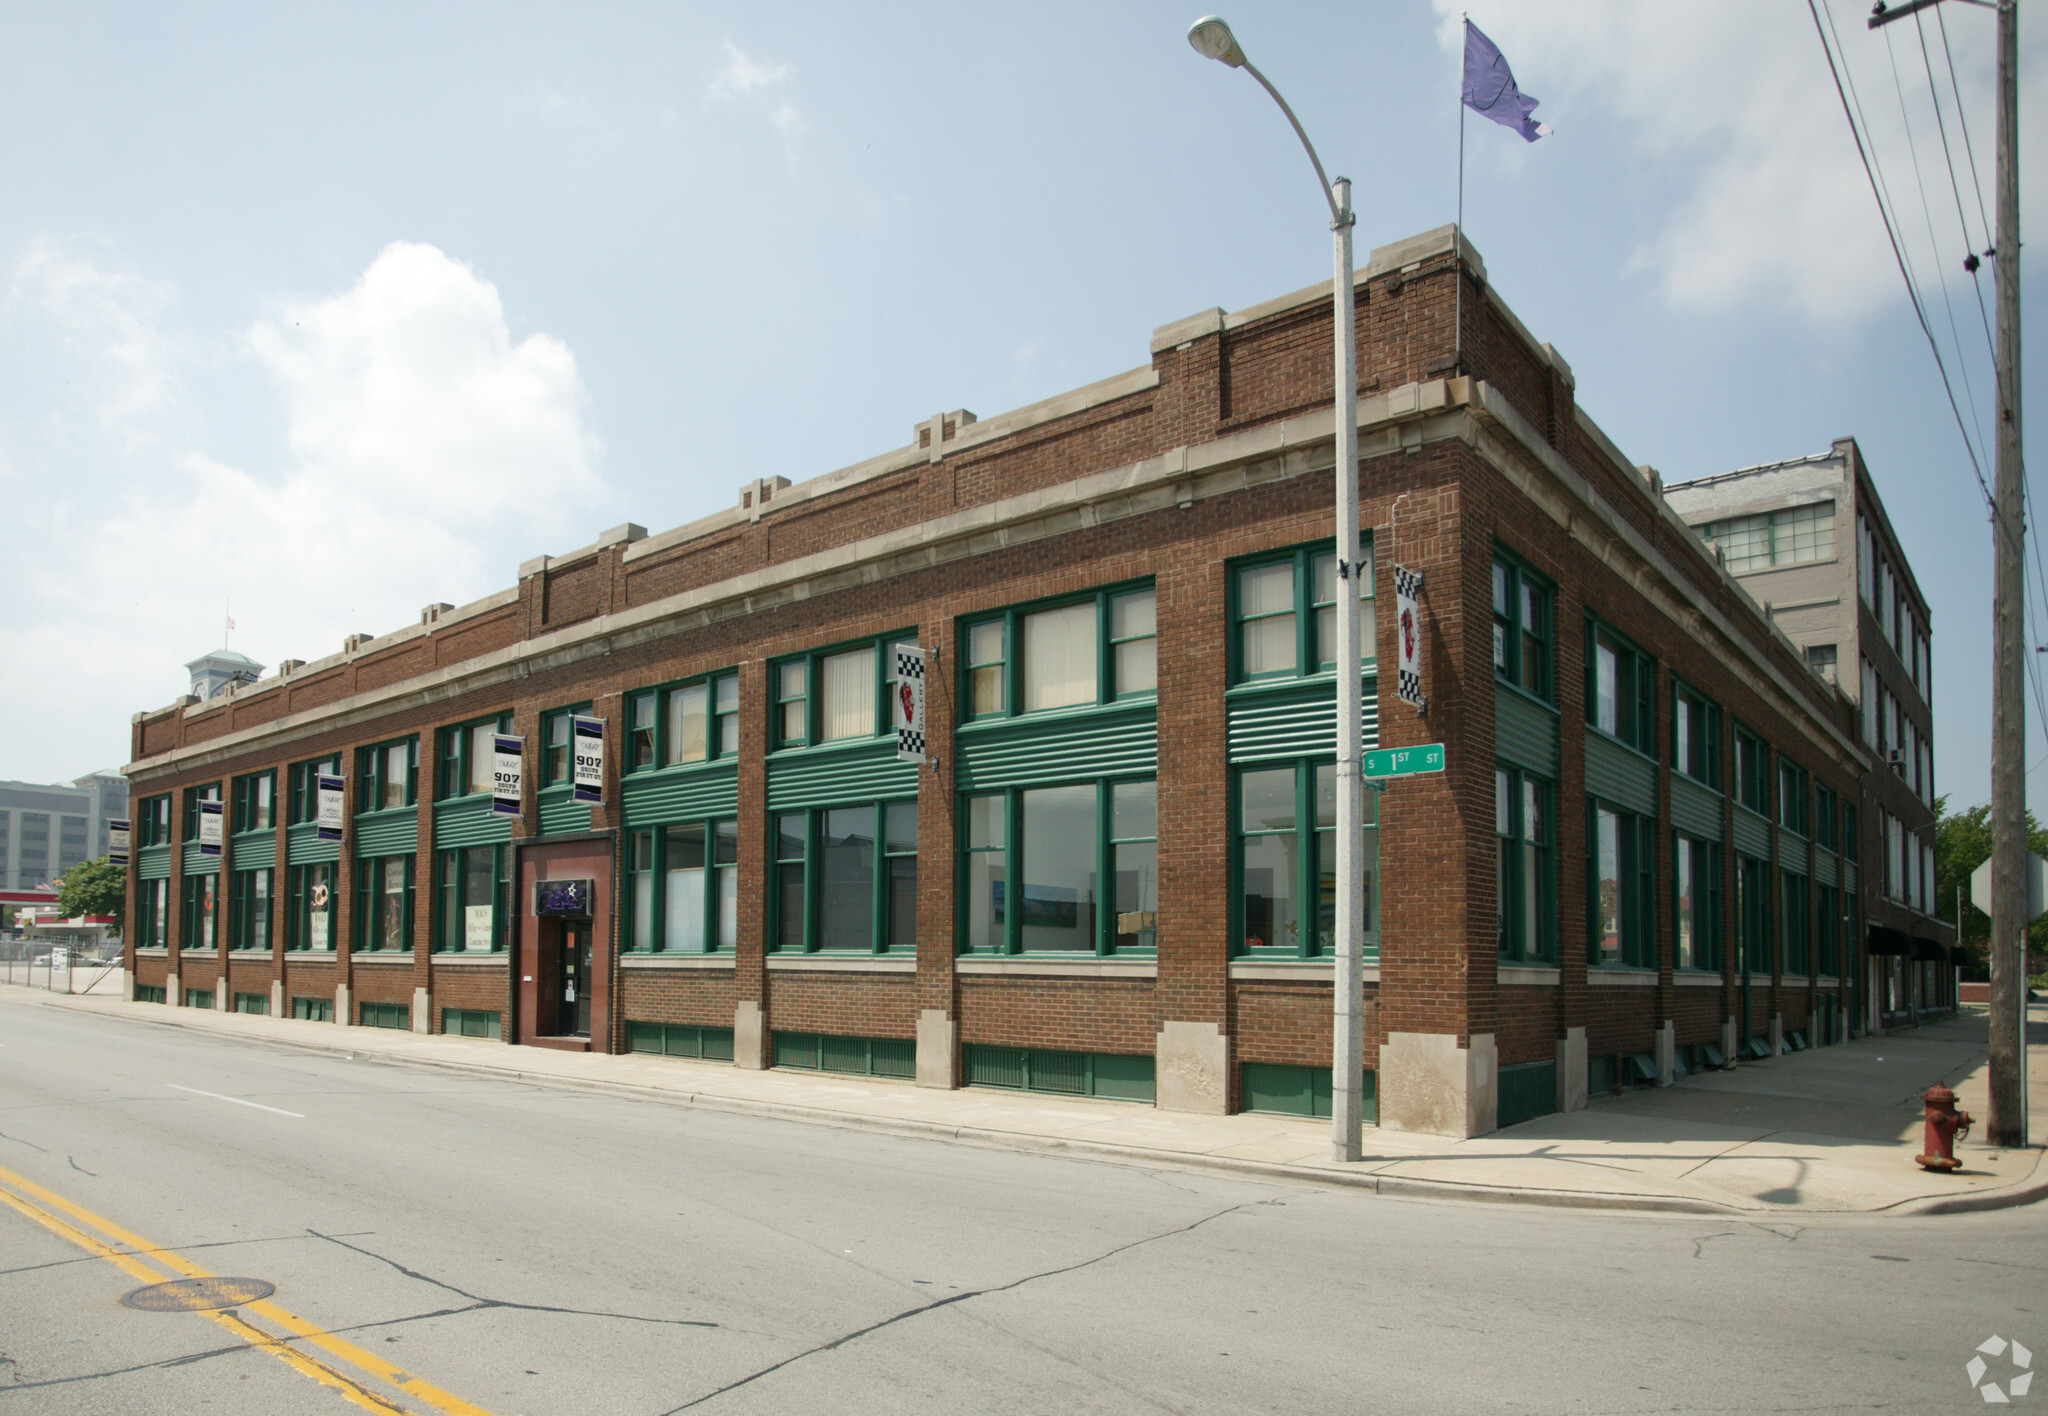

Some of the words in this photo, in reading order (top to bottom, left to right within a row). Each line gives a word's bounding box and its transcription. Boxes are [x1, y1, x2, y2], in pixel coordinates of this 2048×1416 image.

[576, 755, 602, 768] 907
[1368, 759, 1375, 769] S
[1391, 752, 1410, 771] 1ST
[1426, 753, 1439, 764] ST
[576, 771, 592, 779] FIRST
[580, 766, 599, 774] SOUTH
[494, 772, 520, 784] 907
[498, 782, 517, 790] SOUTH
